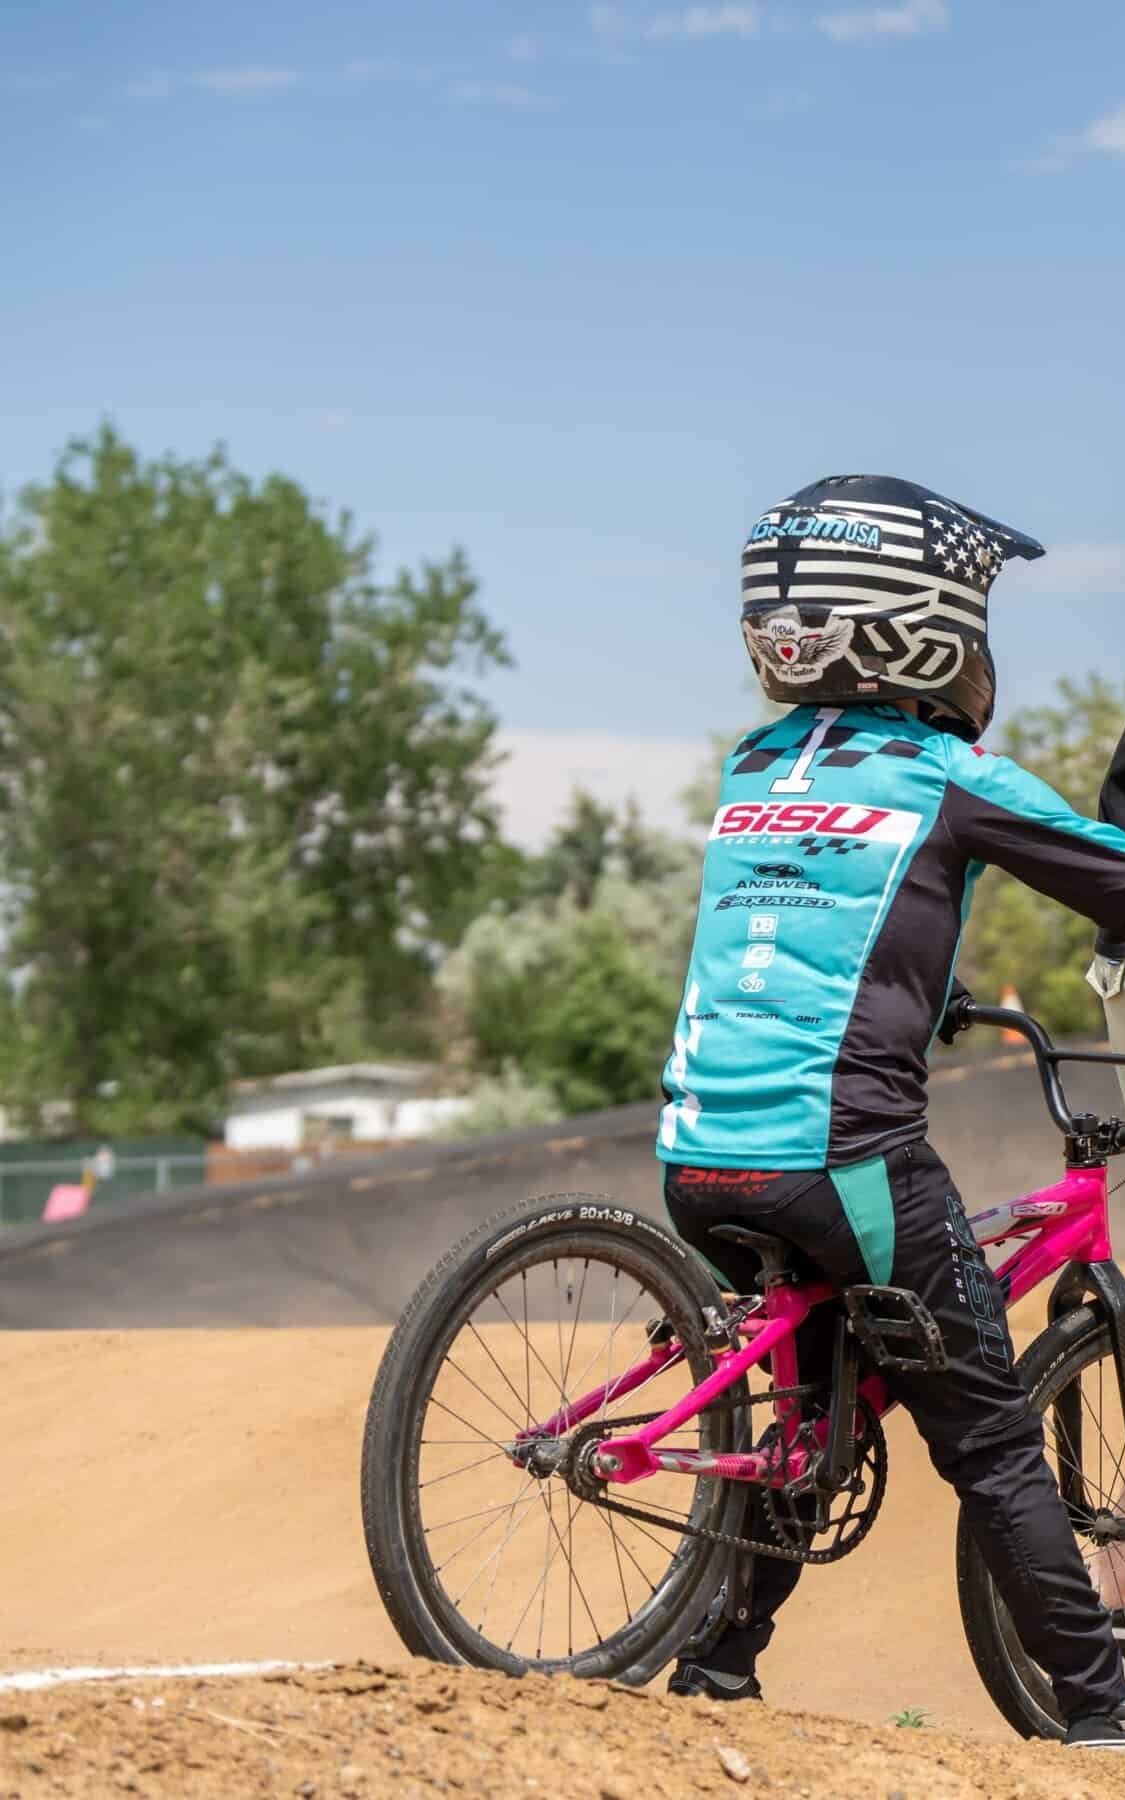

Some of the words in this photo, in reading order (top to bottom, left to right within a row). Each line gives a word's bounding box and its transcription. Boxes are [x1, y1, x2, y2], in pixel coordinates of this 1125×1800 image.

[845, 521, 880, 546] USA
[768, 707, 844, 795] 1
[735, 879, 821, 892] ANSWER
[795, 1014, 823, 1025] GRIT
